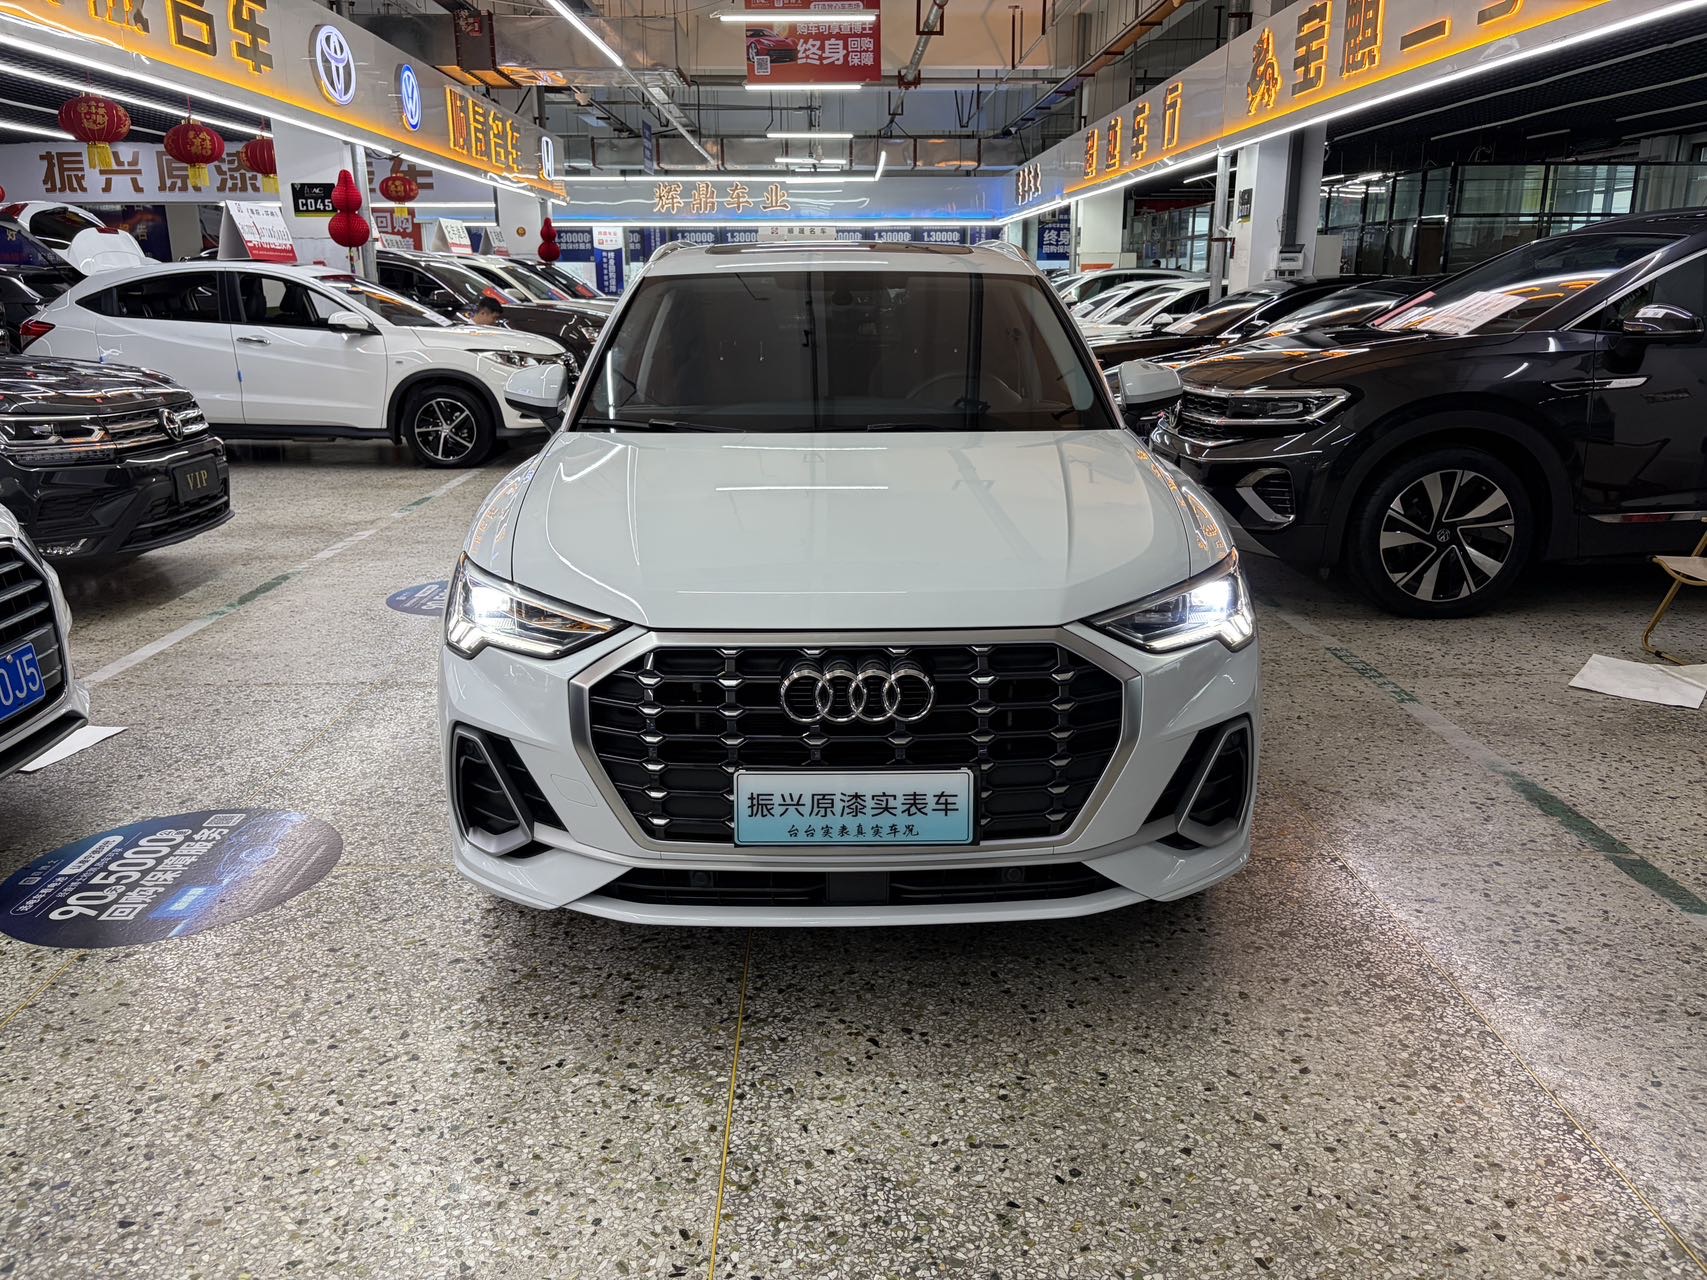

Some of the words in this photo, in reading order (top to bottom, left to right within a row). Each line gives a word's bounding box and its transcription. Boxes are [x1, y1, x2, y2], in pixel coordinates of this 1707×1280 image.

[797, 38, 847, 65] 终身
[847, 37, 874, 51] 回购
[847, 52, 874, 66] 保障
[653, 181, 791, 214] 辉鼎车业
[186, 469, 208, 490] VIP
[747, 792, 959, 818] 振兴原漆实表车
[787, 824, 919, 838] 台台实表真实车况
[97, 828, 230, 920] 回购保障服务
